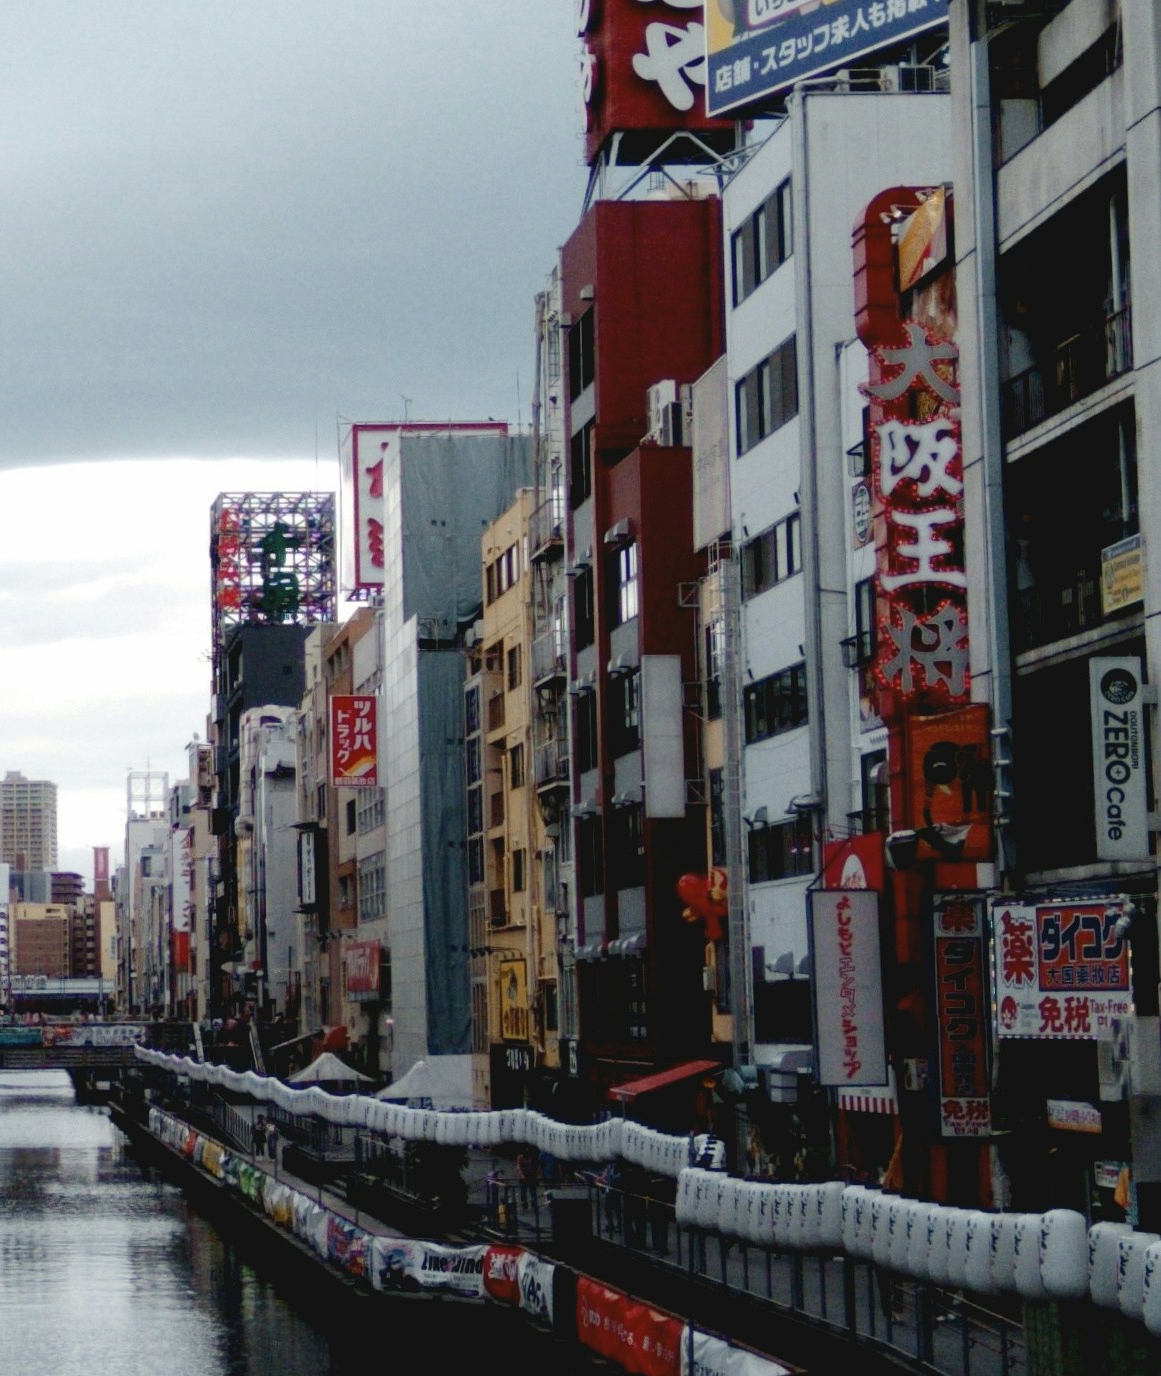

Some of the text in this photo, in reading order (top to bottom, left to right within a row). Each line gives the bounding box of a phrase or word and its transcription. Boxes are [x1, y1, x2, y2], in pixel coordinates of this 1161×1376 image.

[858, 322, 970, 698] 大阪王将
[336, 709, 353, 764] ドラッグ
[353, 700, 373, 751] ツルハ
[1103, 709, 1131, 785] ZERO
[1106, 787, 1127, 841] cafe
[1041, 912, 1125, 962] ダイコク
[943, 939, 977, 1043] ダイコク
[1038, 996, 1091, 1033] 免税
[1090, 999, 1129, 1014] Tax-Free
[942, 1099, 989, 1120] 免税
